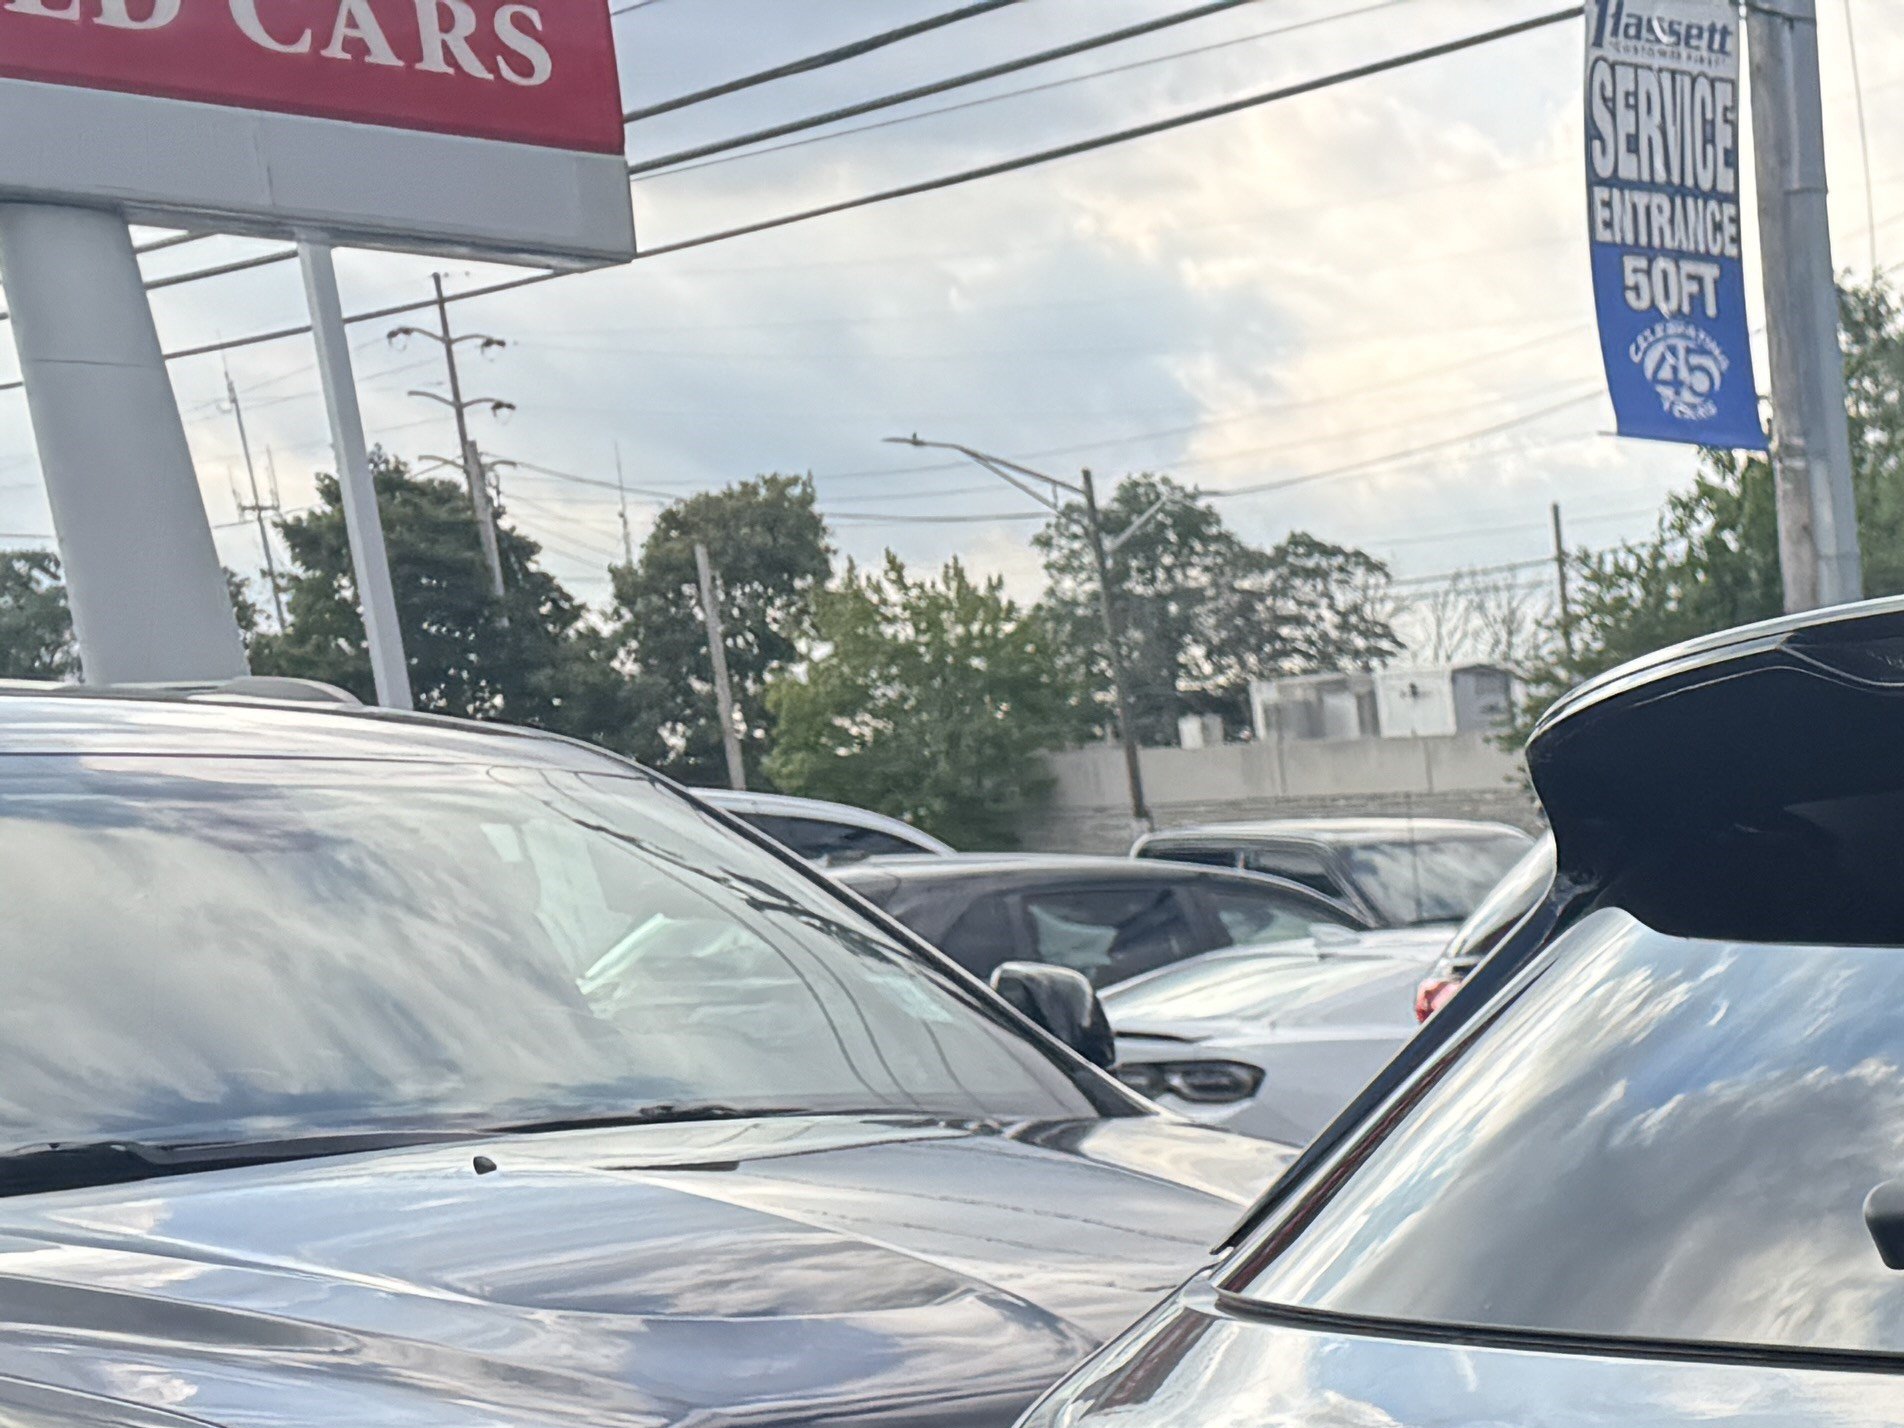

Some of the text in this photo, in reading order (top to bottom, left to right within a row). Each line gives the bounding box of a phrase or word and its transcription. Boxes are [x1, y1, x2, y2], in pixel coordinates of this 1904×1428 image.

[229, 0, 553, 87] CARS
[1590, 57, 1736, 194] SERVICE
[1592, 186, 1738, 259] ENTRANCE
[1622, 254, 1721, 319] 50FT
